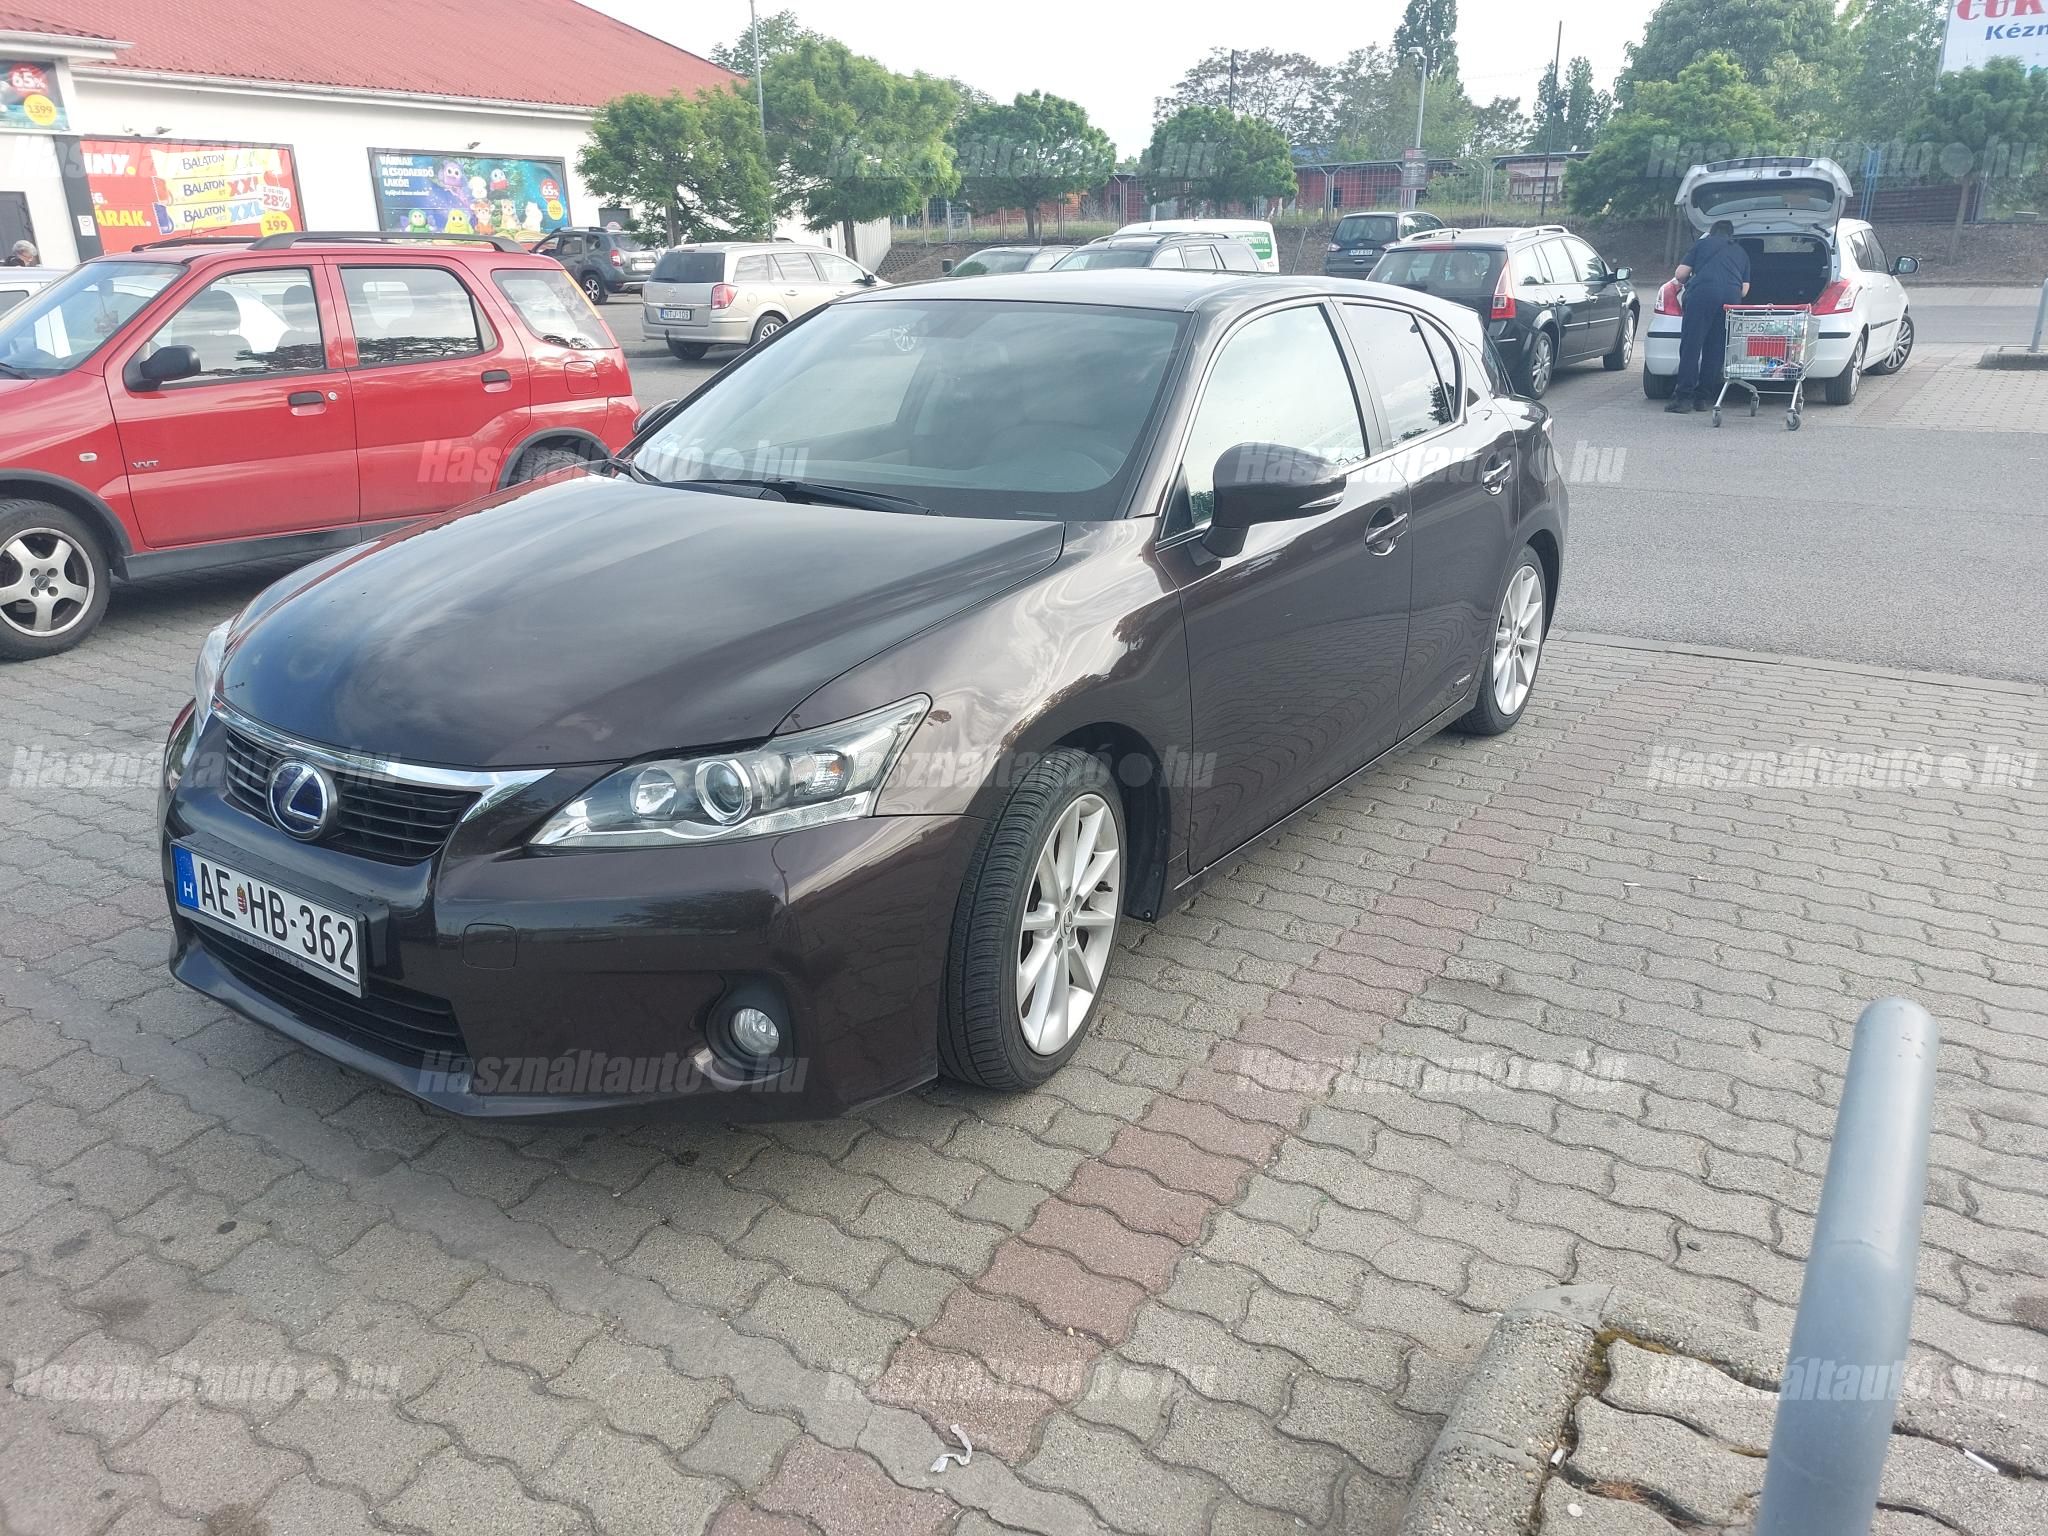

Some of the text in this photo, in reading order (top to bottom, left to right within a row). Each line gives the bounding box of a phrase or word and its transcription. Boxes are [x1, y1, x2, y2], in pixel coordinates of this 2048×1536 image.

[12, 71, 46, 89] 65%
[182, 154, 225, 170] BALATON
[183, 180, 225, 196] BALATON
[263, 194, 290, 209] 28%
[183, 199, 265, 222] BALATON XXL
[266, 220, 288, 231] 199
[132, 460, 159, 468] VVT
[183, 880, 194, 899] H
[201, 862, 355, 975] AE HB-362
